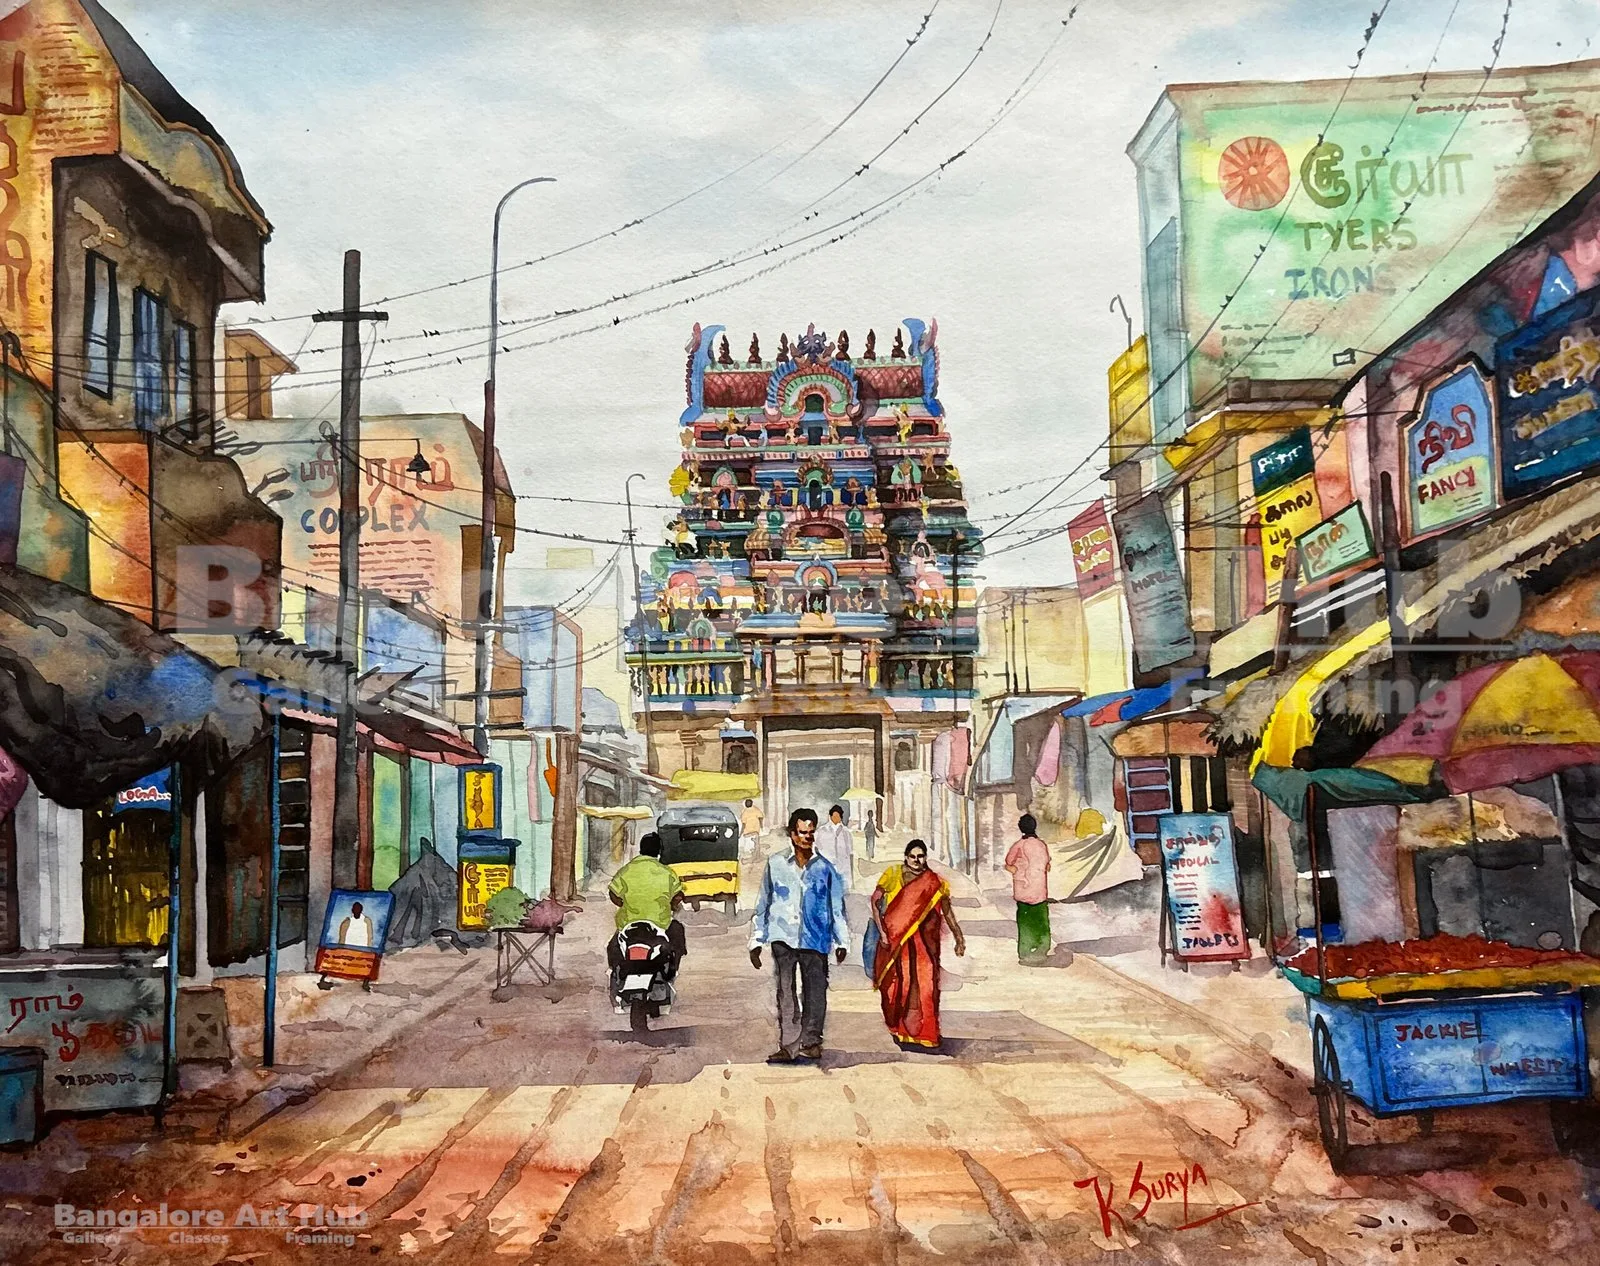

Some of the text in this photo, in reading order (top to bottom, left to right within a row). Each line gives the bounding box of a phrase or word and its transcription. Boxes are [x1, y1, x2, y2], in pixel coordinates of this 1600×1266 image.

[1294, 217, 1418, 252] TYERS
[1417, 465, 1476, 504] FANCY
[300, 504, 430, 534] COPLEX
[1394, 1021, 1477, 1042] JACKIE
[1129, 1160, 1208, 1226] SURYA
